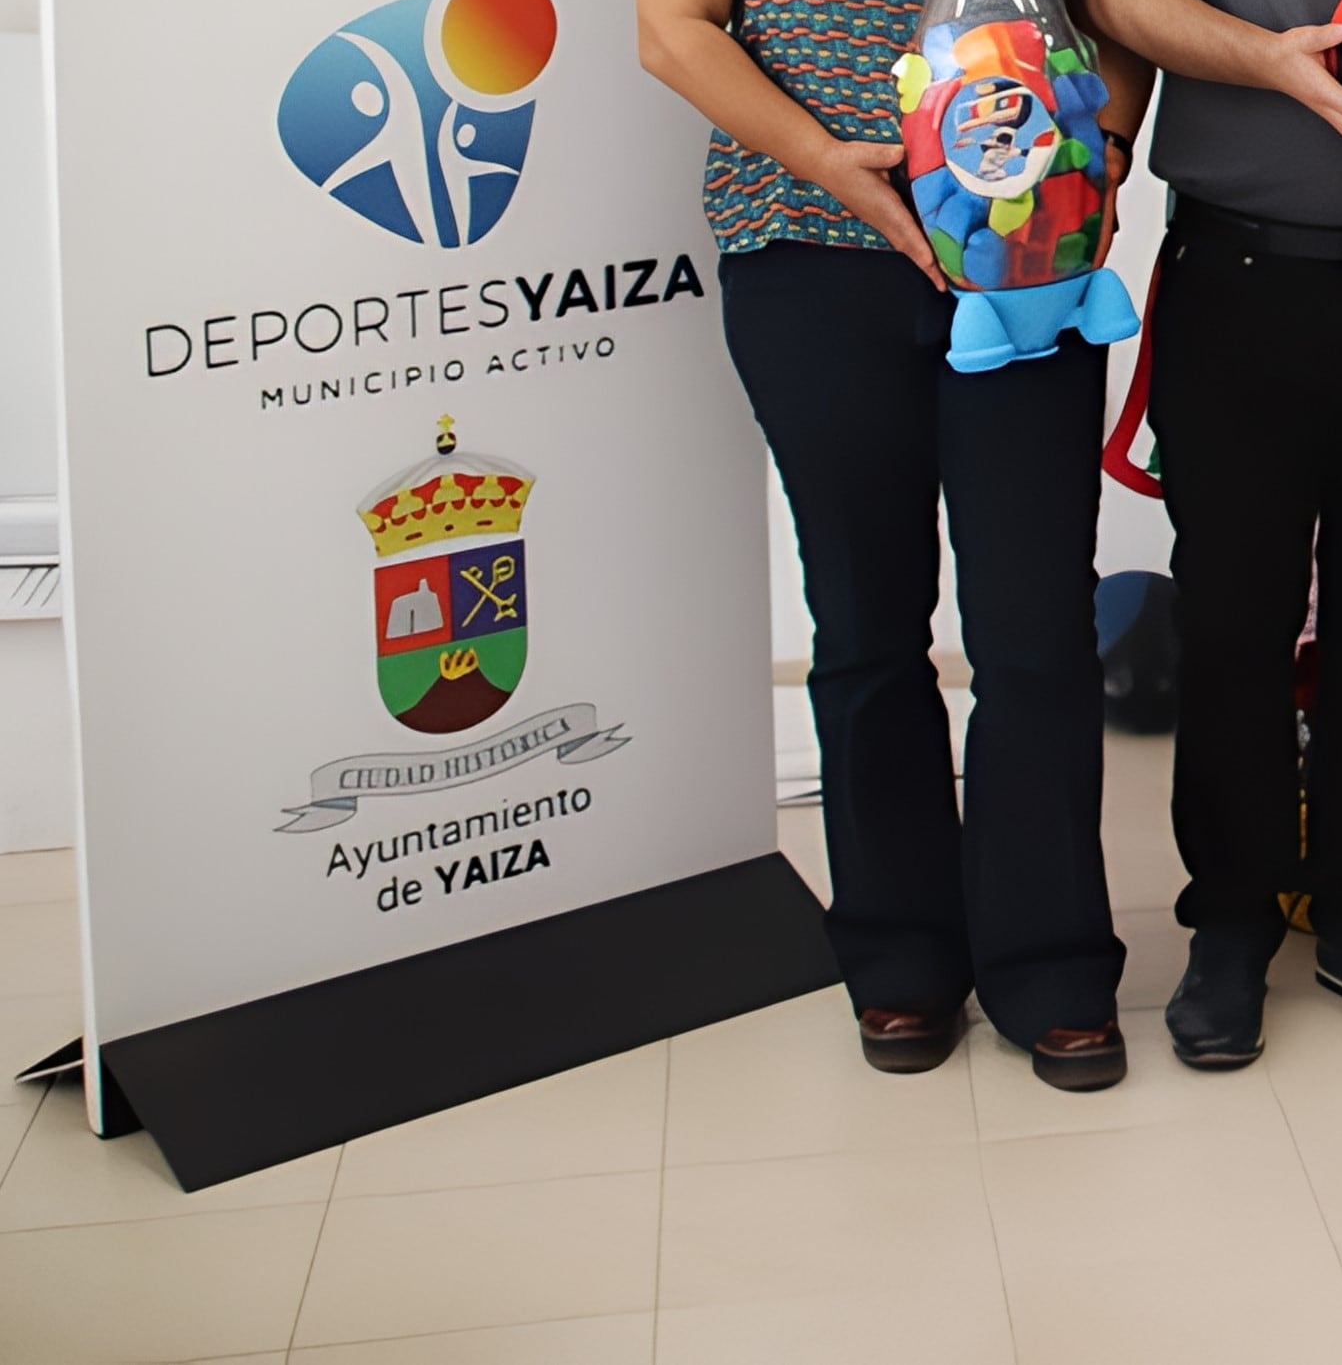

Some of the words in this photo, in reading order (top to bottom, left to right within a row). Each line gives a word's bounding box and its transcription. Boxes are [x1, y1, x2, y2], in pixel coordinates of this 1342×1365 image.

[259, 360, 466, 409] MUNICIPIO
[485, 336, 616, 375] ACTIVO
[325, 786, 593, 879] Ayuntamiento
[376, 876, 423, 912] de
[434, 839, 551, 895] YAIZA
